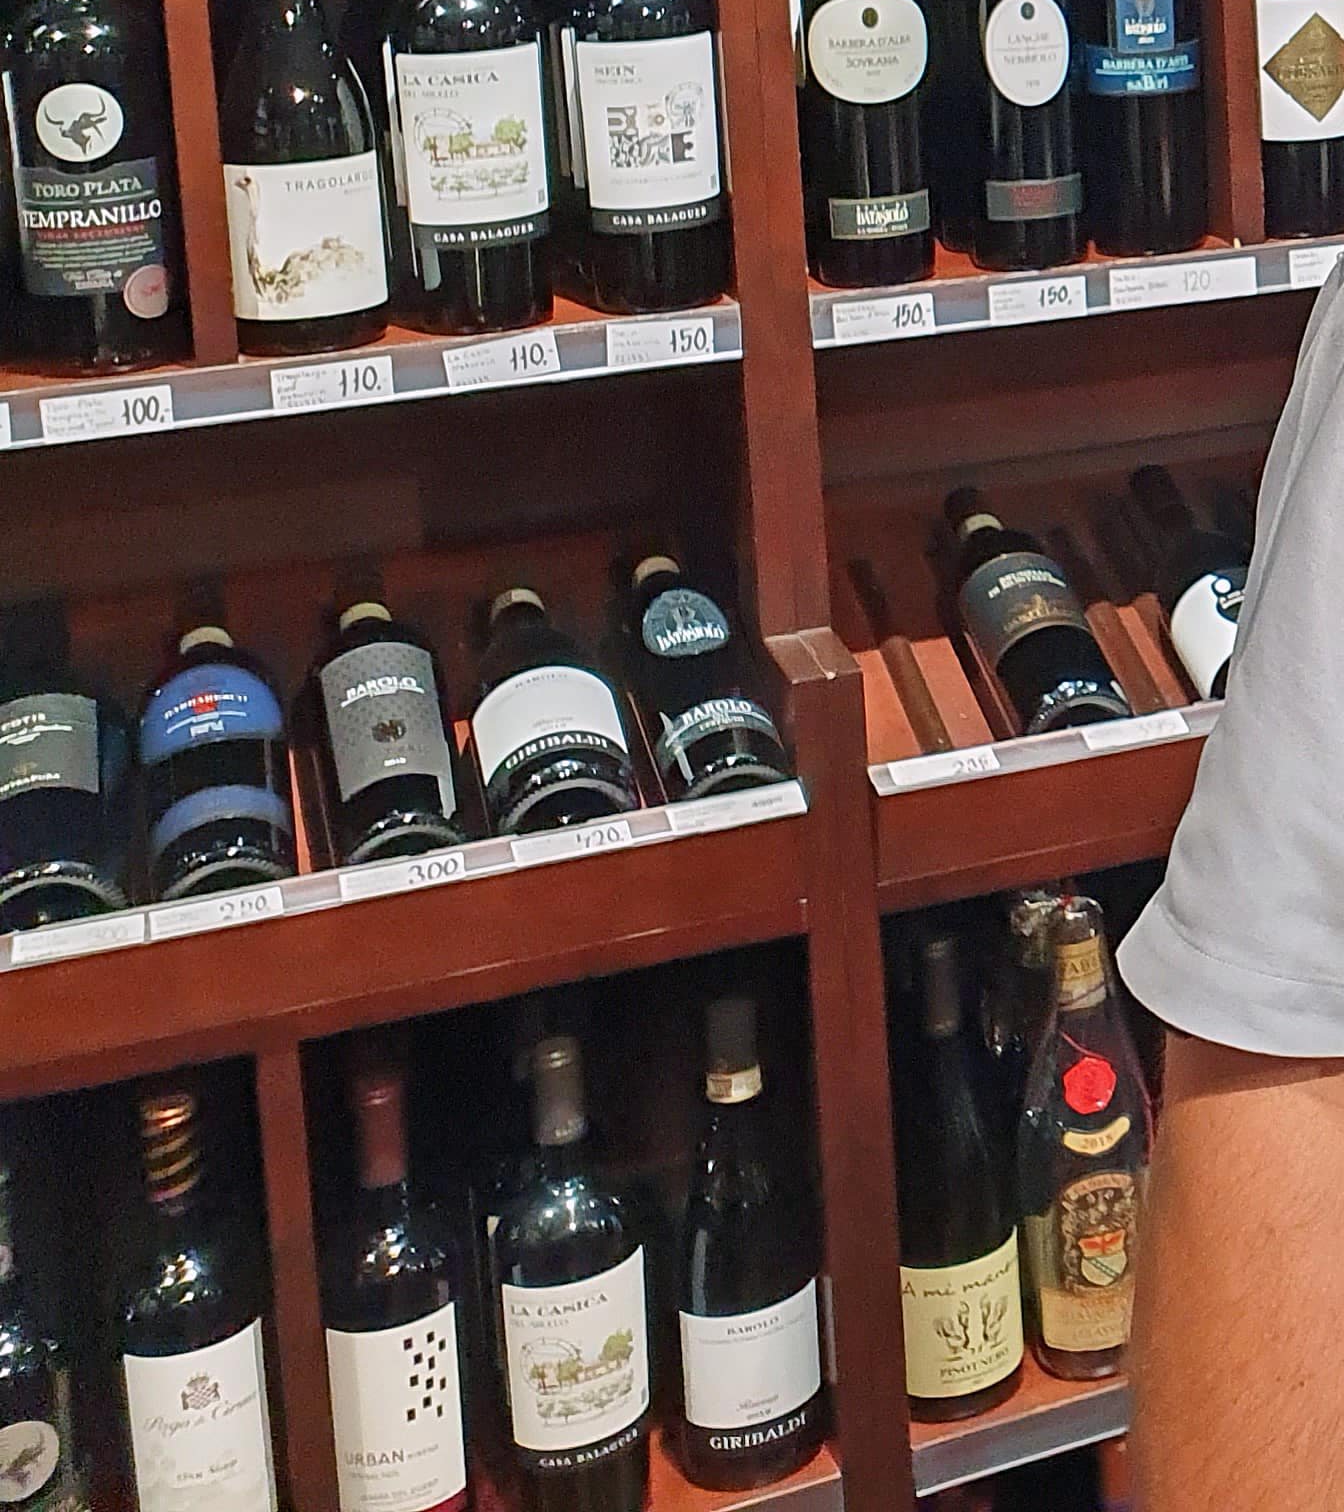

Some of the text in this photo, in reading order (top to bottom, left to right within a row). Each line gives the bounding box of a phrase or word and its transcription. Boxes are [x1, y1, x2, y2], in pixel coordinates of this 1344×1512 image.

[32, 175, 143, 198] TORO PLATA
[23, 199, 162, 229] TEMPRANILLO
[612, 213, 643, 227] CASA
[433, 230, 466, 244] CASA
[505, 733, 608, 769] GIRIBALDI
[709, 1412, 808, 1451] GIRIBALDI
[343, 1448, 405, 1469] URBAN
